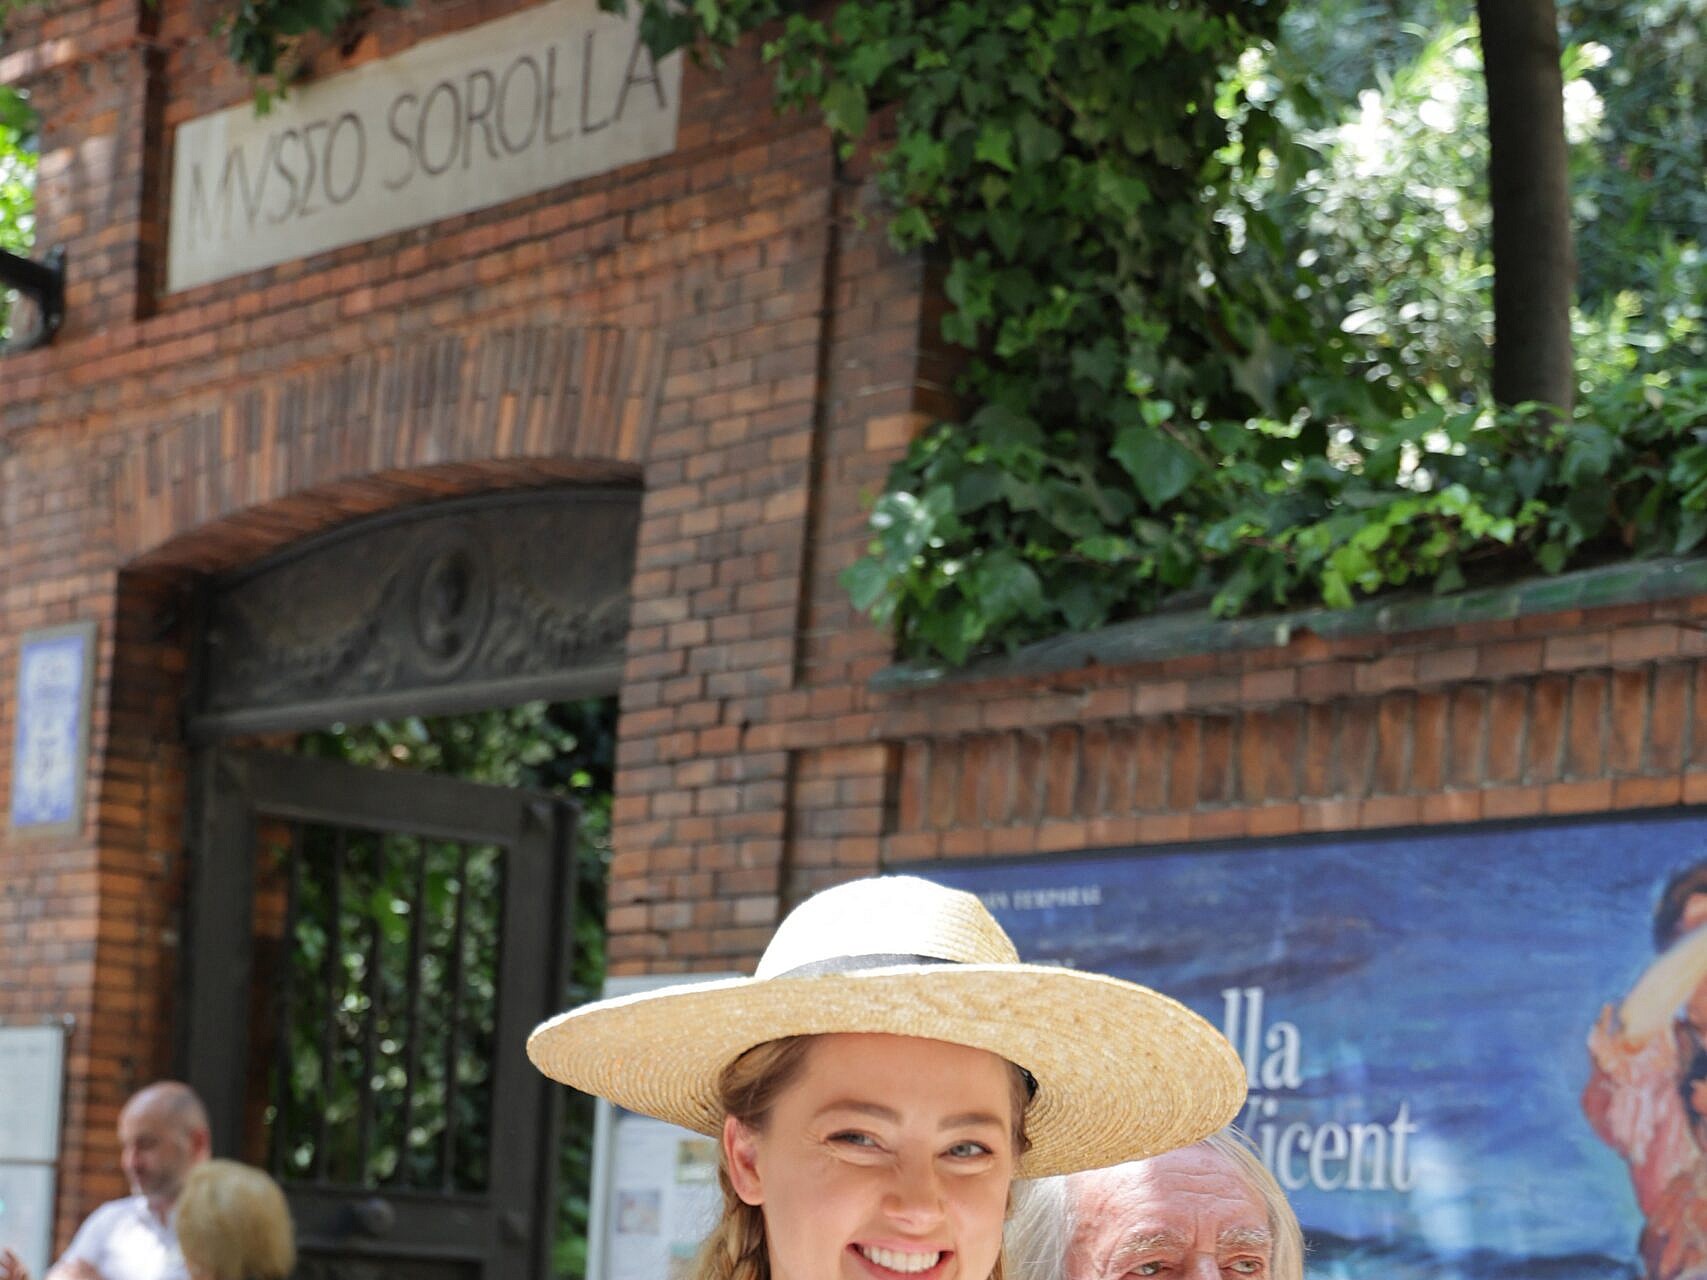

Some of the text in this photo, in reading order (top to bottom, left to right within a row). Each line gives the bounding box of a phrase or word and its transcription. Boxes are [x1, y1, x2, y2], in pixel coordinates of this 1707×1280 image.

[384, 24, 668, 191] SOROLLA
[1221, 986, 1302, 1089] lla
[1245, 1095, 1419, 1192] icent
